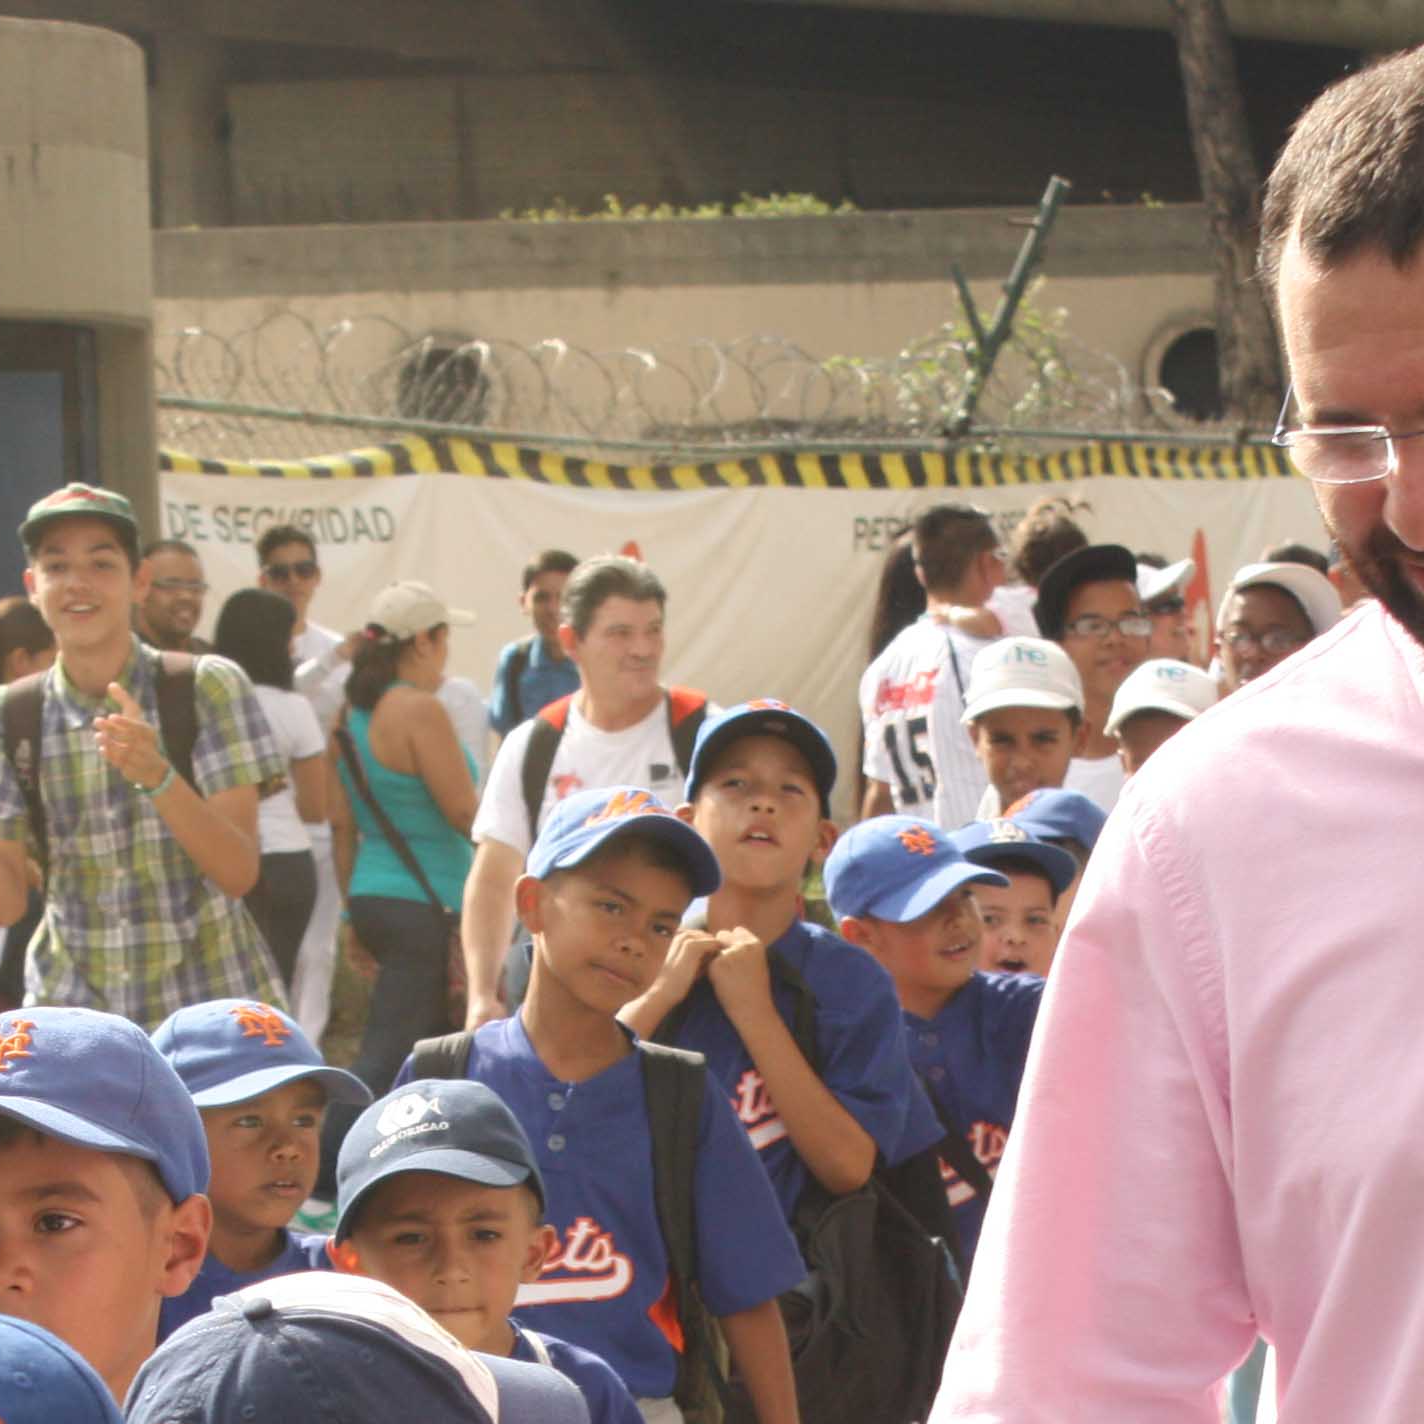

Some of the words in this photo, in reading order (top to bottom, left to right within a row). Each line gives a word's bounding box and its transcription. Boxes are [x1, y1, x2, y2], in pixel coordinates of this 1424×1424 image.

[165, 502, 207, 541] DE
[884, 717, 938, 805] 15
[542, 1216, 634, 1274] ts
